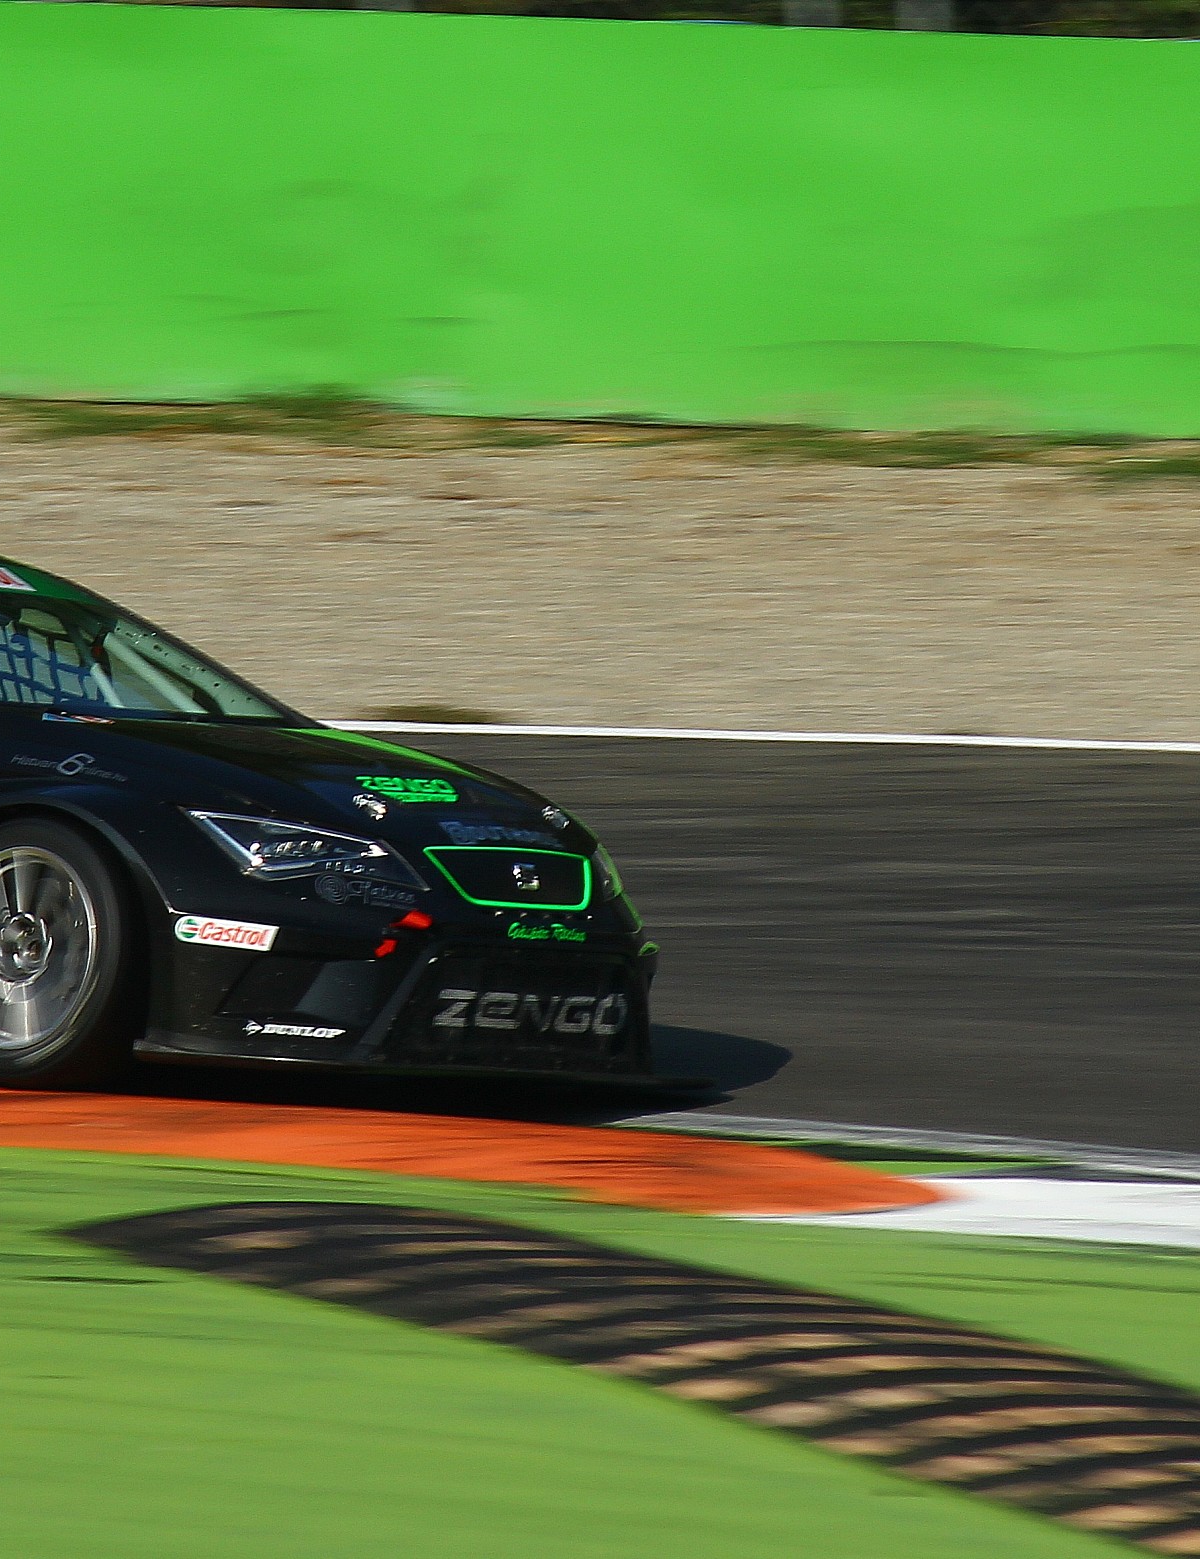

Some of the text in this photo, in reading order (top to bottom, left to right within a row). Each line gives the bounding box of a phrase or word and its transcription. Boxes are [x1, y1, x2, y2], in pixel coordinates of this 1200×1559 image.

[356, 776, 456, 794] ZENGO
[199, 921, 267, 947] Castrol
[259, 1023, 347, 1039] DUNLOP
